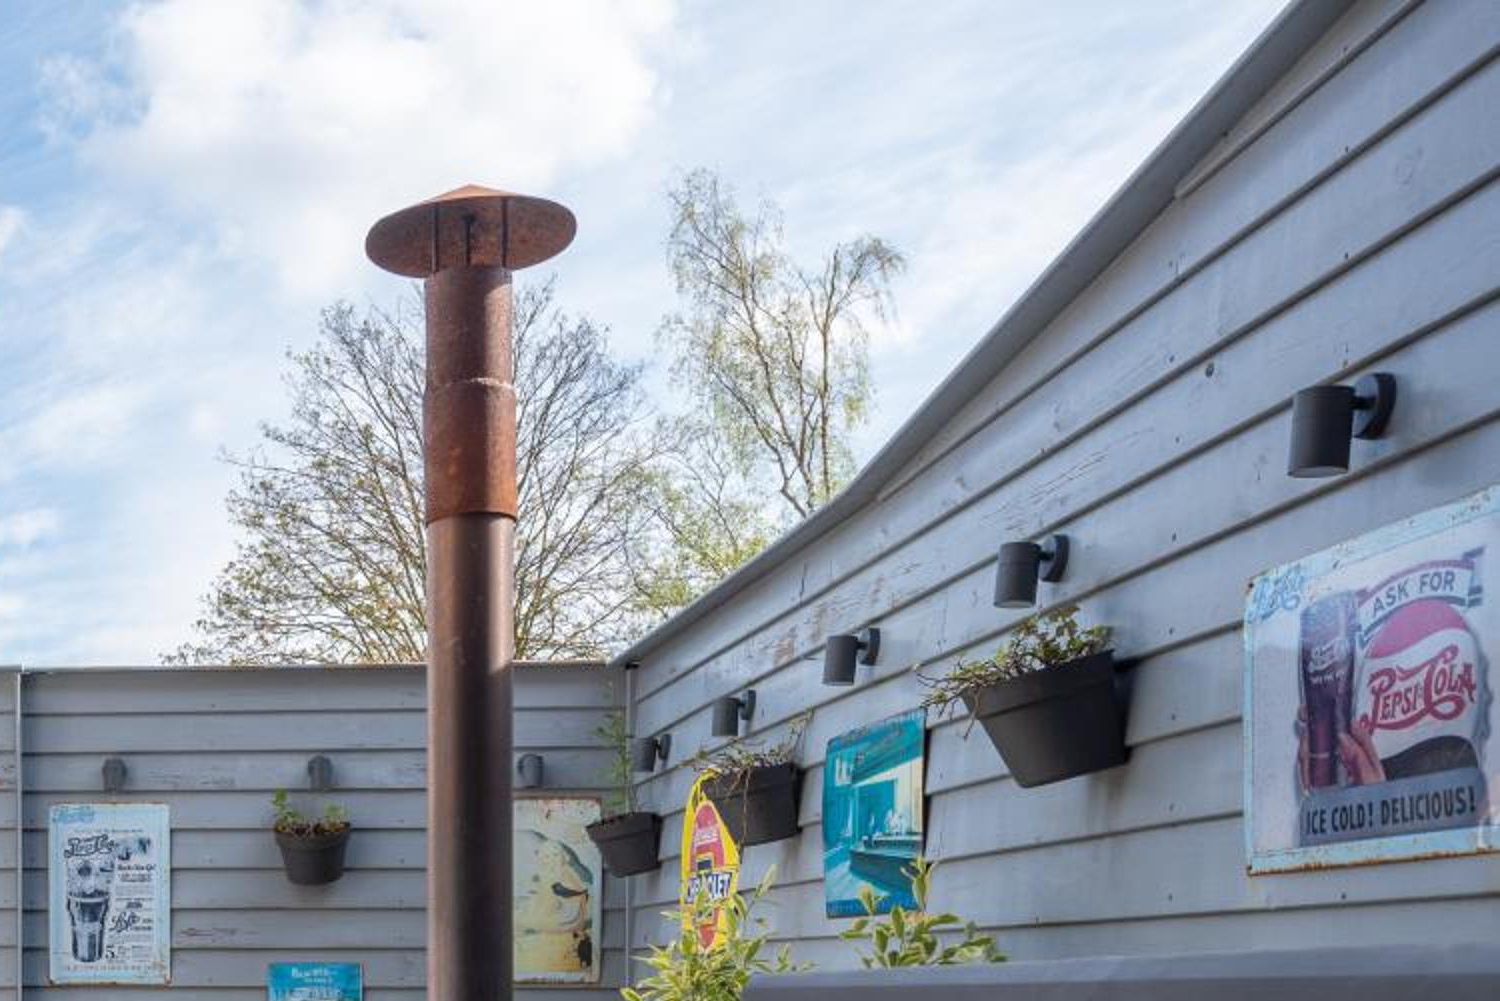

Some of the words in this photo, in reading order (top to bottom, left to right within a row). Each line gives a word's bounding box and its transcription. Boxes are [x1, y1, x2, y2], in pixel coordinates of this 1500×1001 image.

[1373, 578, 1410, 618] ASK
[1419, 570, 1456, 594] FOR
[1306, 808, 1327, 836] ICE
[1331, 802, 1374, 832] COLD!
[1380, 785, 1477, 826] DELICIOUS!
